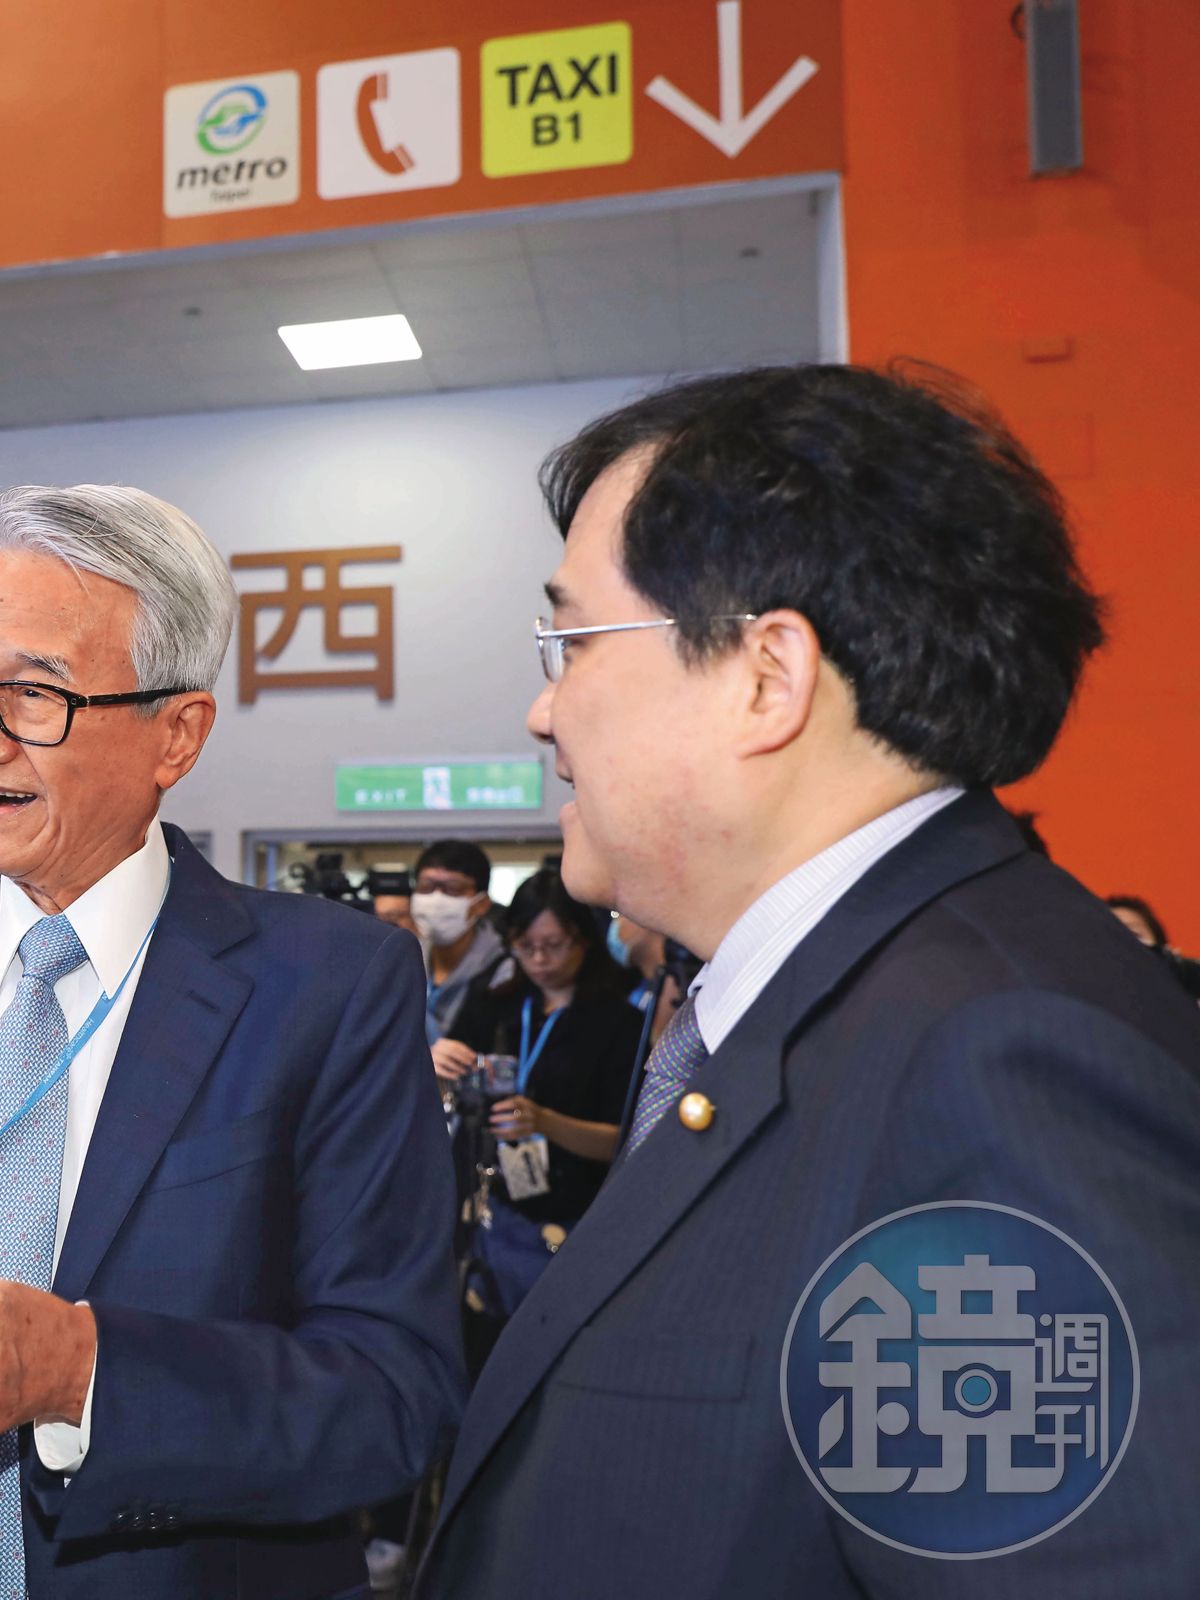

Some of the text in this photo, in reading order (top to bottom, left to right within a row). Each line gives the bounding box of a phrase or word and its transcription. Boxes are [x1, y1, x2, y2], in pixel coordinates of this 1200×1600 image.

[497, 53, 618, 107] TAXI
[532, 112, 581, 147] B1
[176, 156, 288, 189] metro
[230, 545, 403, 705] 西
